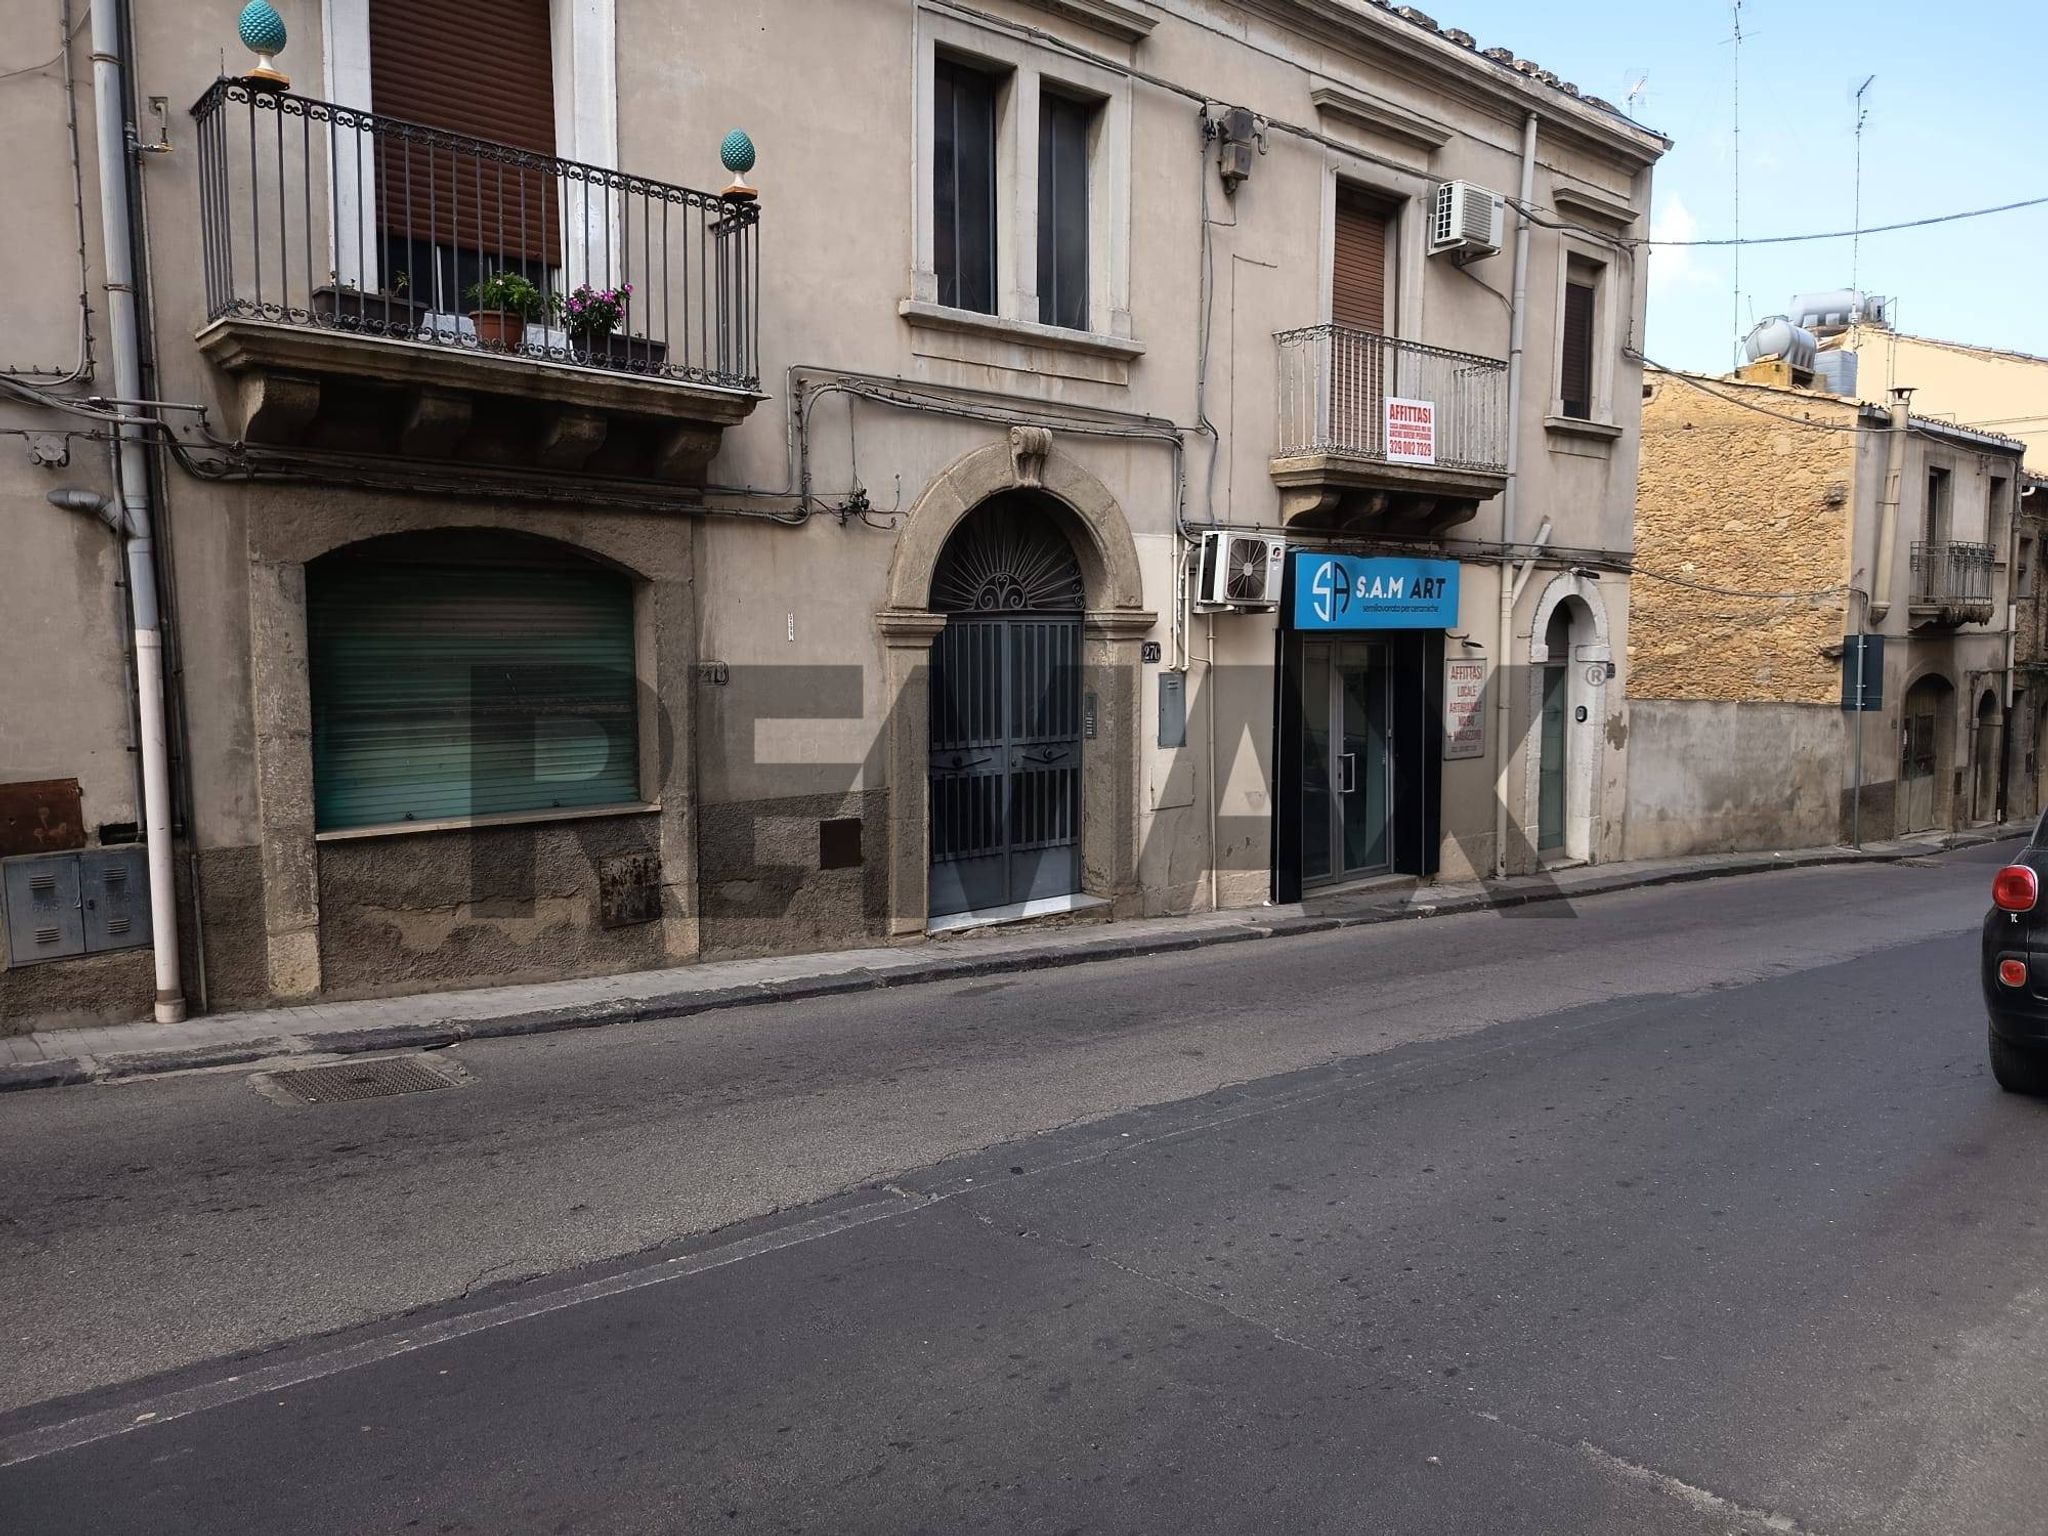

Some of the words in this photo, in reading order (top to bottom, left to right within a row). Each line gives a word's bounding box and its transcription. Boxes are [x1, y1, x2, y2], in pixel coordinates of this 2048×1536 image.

[1389, 403, 1431, 424] AFFITTASI
[1389, 439, 1402, 454] 329
[1356, 576, 1404, 598] S.A.M
[1409, 577, 1446, 599] ART
[1450, 666, 1482, 680] AFFITTASI
